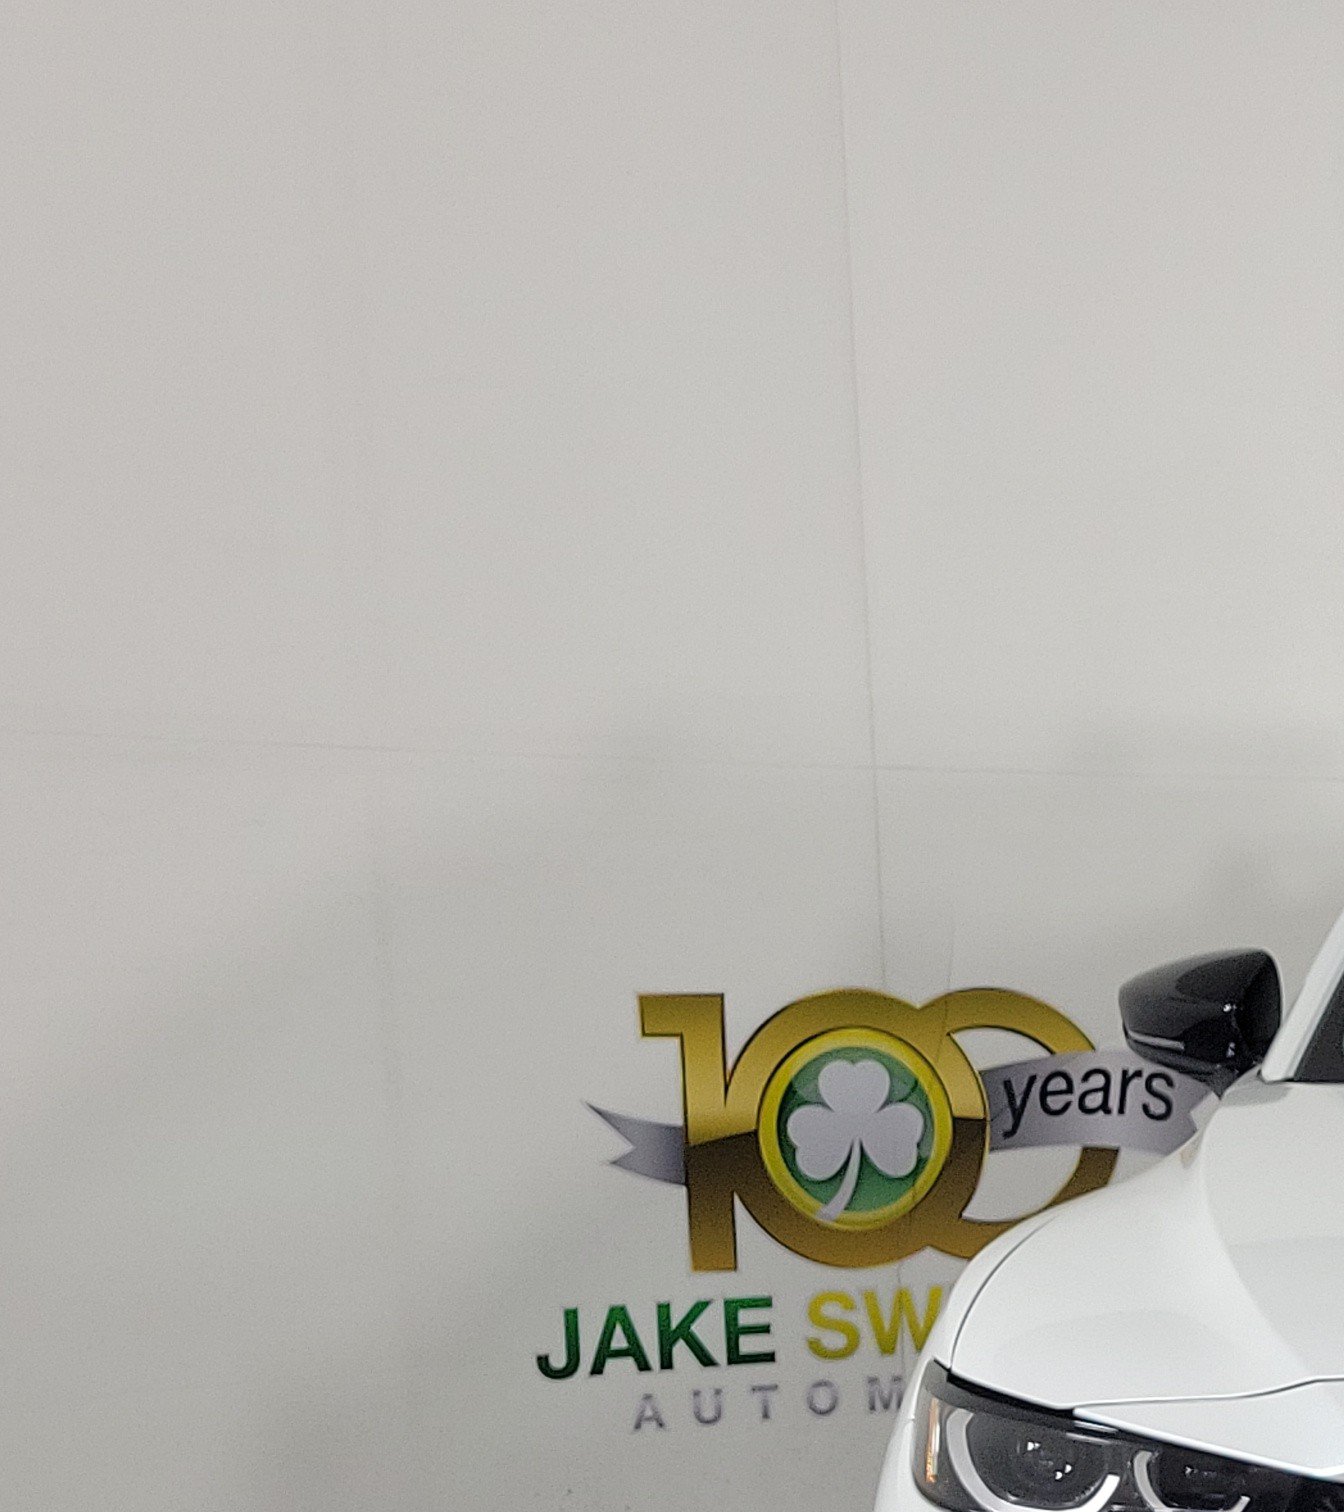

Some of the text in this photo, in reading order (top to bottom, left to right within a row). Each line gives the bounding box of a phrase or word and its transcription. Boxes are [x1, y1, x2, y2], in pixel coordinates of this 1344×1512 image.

[637, 987, 1176, 1271] 100 years
[536, 1296, 776, 1381] JAKE
